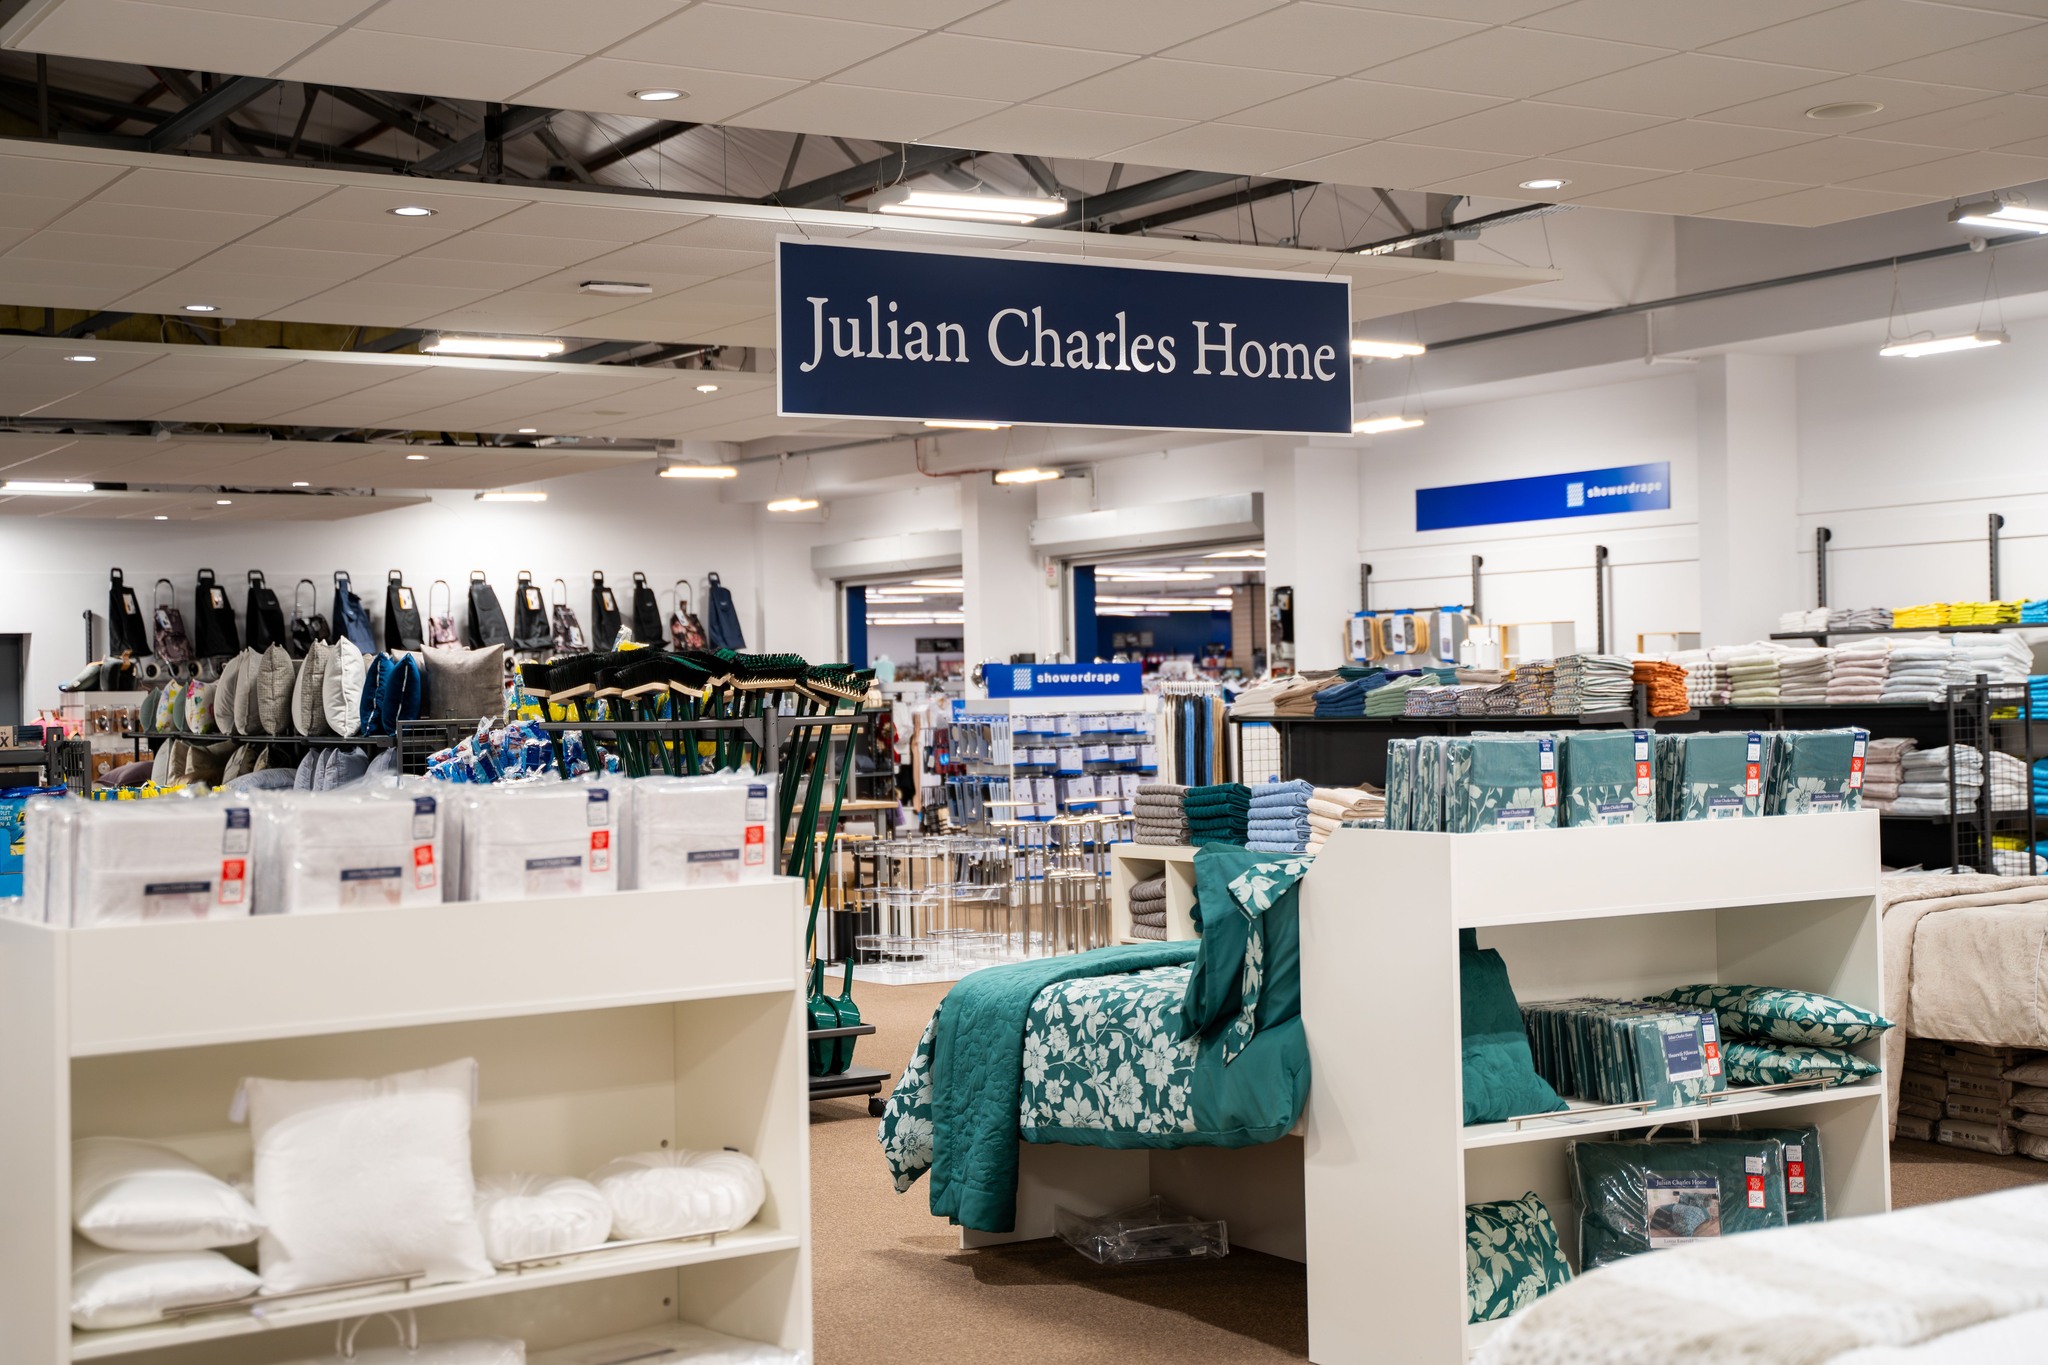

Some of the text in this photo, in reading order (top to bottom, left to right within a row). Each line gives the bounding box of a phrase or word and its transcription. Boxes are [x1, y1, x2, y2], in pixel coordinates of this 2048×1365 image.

[799, 295, 1337, 382] Julian Charles Home
[1586, 482, 1662, 499] showerdrape
[1036, 671, 1121, 685] showerdrape
